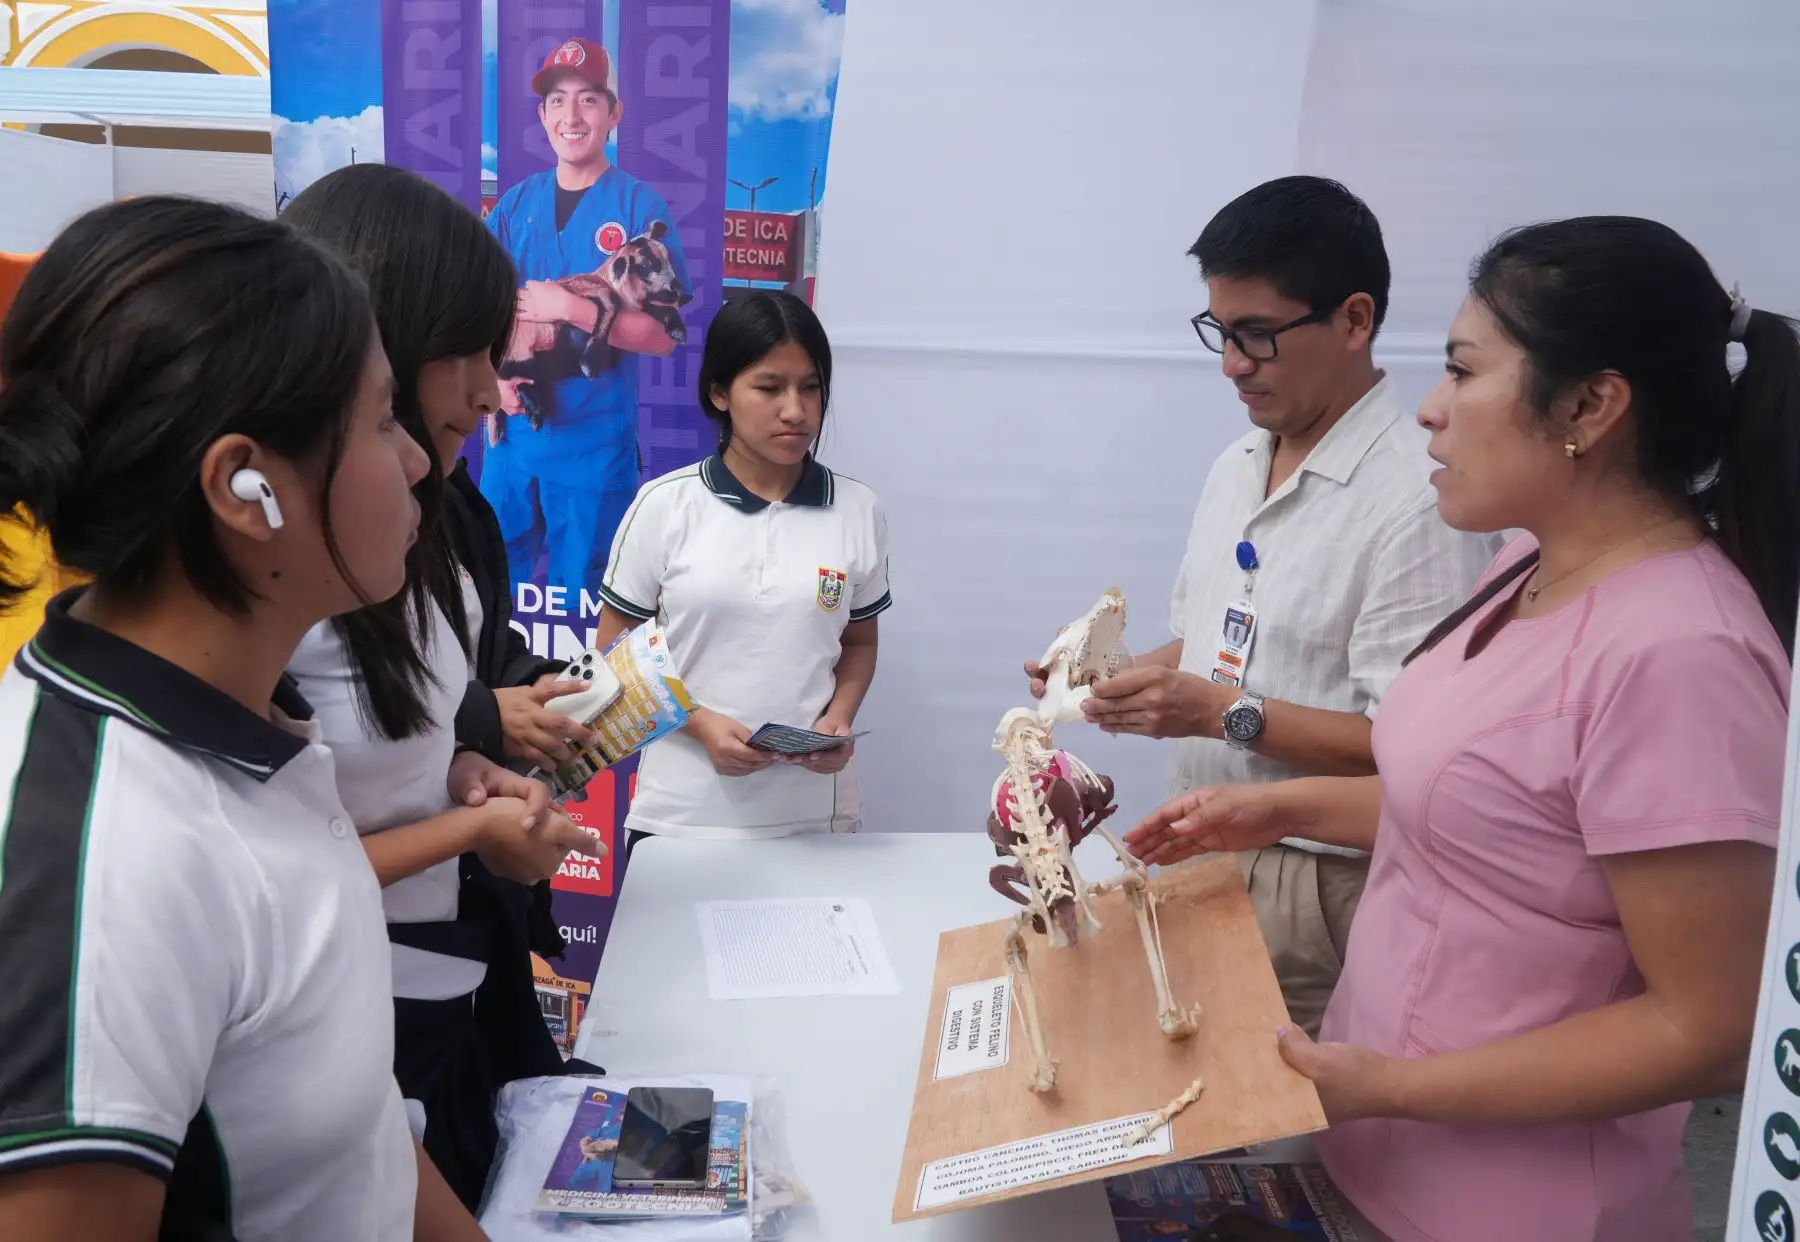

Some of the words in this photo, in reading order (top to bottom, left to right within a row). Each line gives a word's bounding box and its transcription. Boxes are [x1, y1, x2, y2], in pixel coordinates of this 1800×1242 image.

[723, 217, 747, 237] DE
[754, 220, 788, 241] ICA
[723, 247, 786, 267] TECNIA
[517, 582, 567, 616] DE
[568, 812, 583, 821] CO
[556, 861, 601, 881] ARIA
[558, 925, 597, 944] quí!
[971, 1000, 983, 1016] CON
[991, 985, 1004, 1028] ESQUELETO
[948, 1009, 963, 1050] DIGESTIVO
[968, 1016, 982, 1051] SISTEMA
[988, 1029, 1000, 1057] FELINO
[935, 1156, 980, 1170] CASTRO
[1051, 1130, 1098, 1144] THOMAS
[1102, 1116, 1154, 1132] EDUARD
[1056, 1141, 1092, 1153] DIEGO
[1096, 1131, 1133, 1144] ARMA
[1078, 1147, 1108, 1158] FRED
[959, 1178, 1017, 1195] BAUTISTA
[1068, 1154, 1128, 1171] CAROLINE
[546, 1188, 617, 1200] MEDICINA
